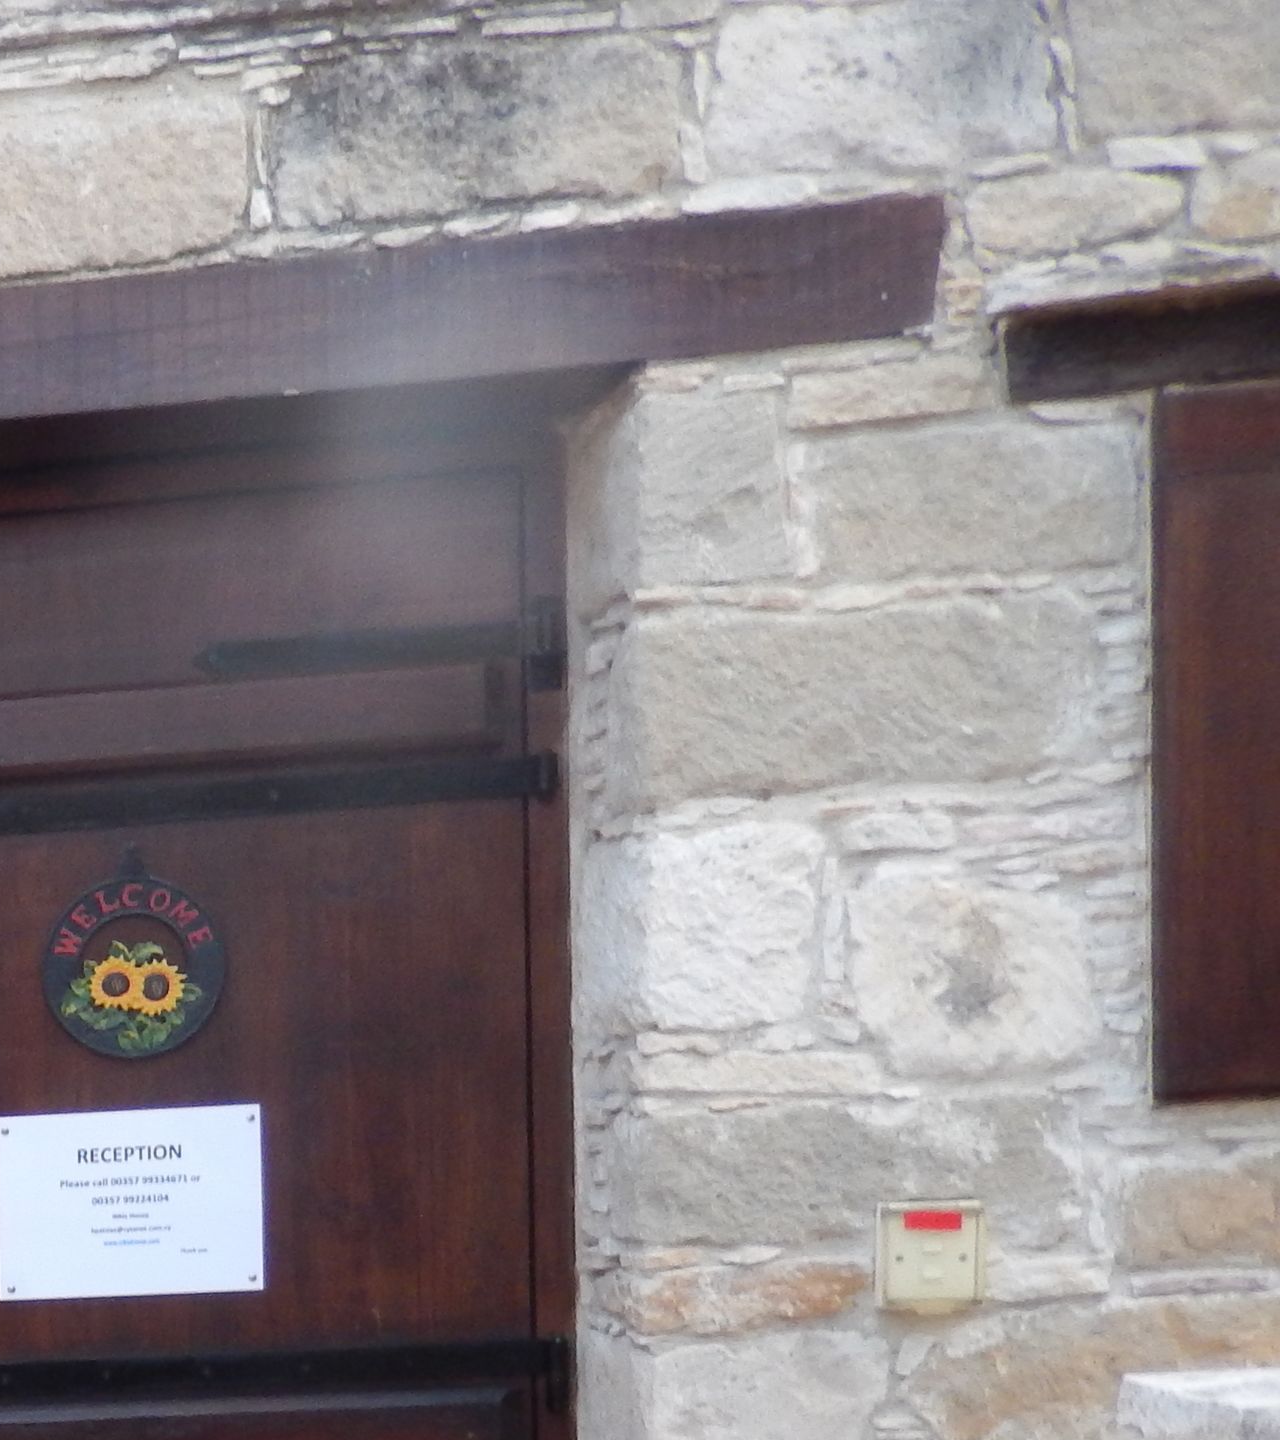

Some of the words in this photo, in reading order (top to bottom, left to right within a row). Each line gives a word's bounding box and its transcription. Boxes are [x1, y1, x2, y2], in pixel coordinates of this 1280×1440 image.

[53, 883, 214, 956] WELCOME
[77, 1144, 182, 1164] RECEPTION
[59, 1179, 90, 1189] Please
[92, 1178, 108, 1187] call
[191, 1175, 201, 1183] or
